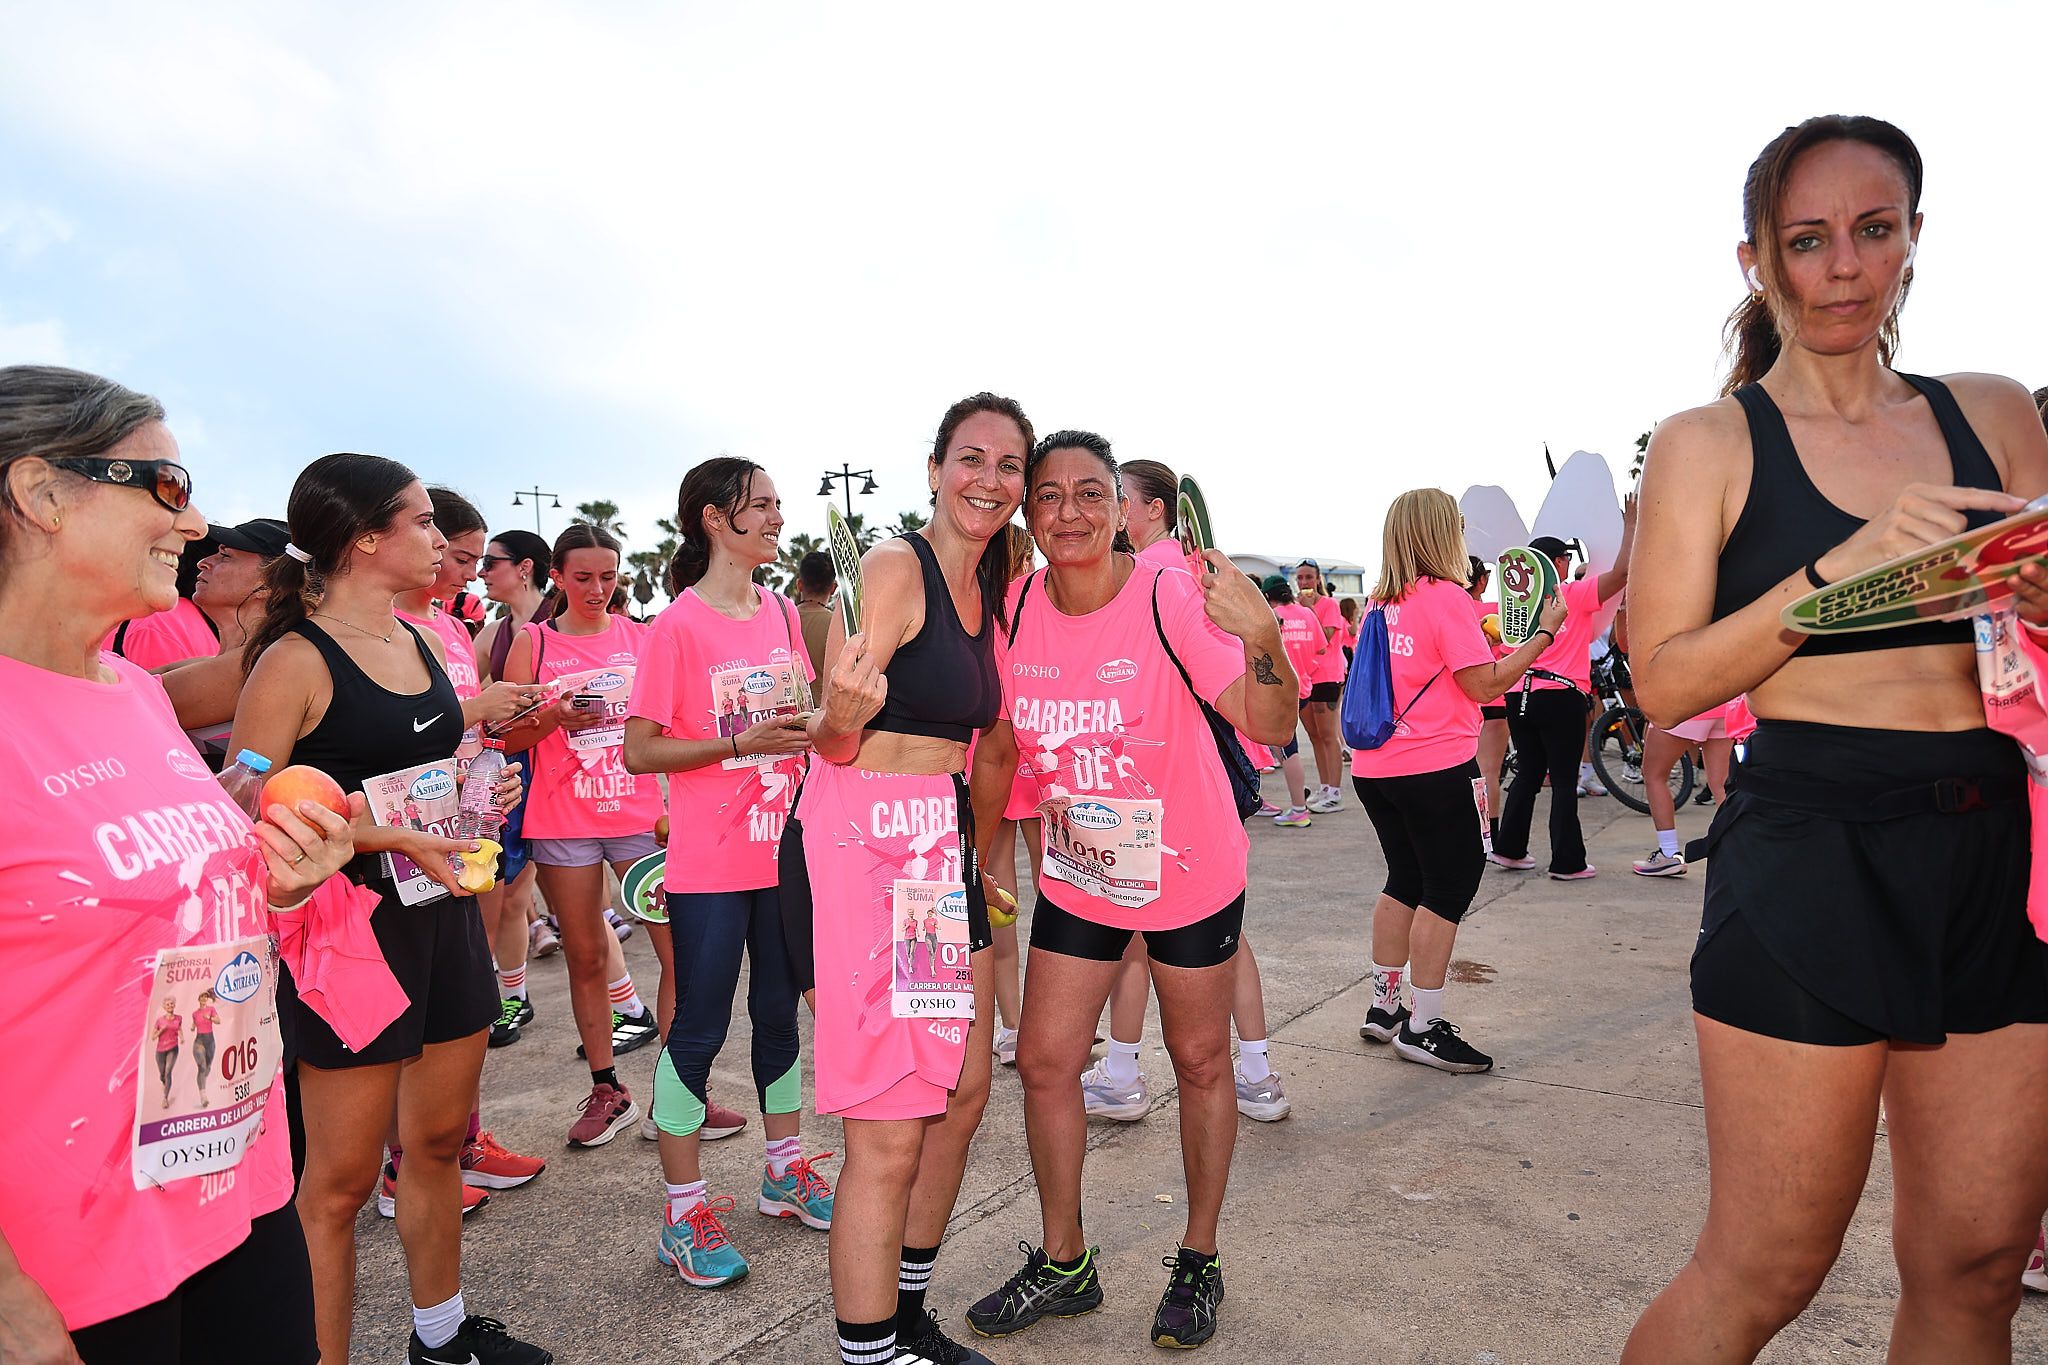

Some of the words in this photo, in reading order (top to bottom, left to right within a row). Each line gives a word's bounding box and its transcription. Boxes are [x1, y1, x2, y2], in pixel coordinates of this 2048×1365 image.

[1819, 551, 1957, 604] CUIDARSE
[1818, 582, 1927, 623] GOZADA
[1820, 600, 1849, 614] ES
[1858, 576, 1915, 602] UNA
[1384, 604, 1400, 626] OS
[1513, 627, 1520, 636] ES
[709, 658, 748, 675] OYSHO
[1013, 663, 1060, 679] OYSHO
[1013, 696, 1125, 734] CARRERA
[580, 735, 607, 745] OYSHO
[44, 757, 126, 797] OYSHO
[1071, 746, 1113, 790] DE
[381, 784, 407, 796] SUMA
[574, 774, 636, 799] MUJER
[596, 799, 620, 813] 2026
[750, 811, 785, 841] MU
[1070, 810, 1117, 825] ASTURIANA
[93, 800, 258, 881] CARRERA
[1072, 841, 1117, 867] 016
[1055, 865, 1087, 886] OYSHO
[1114, 879, 1145, 889] VALENCIA
[907, 893, 934, 902] SUMA
[1108, 890, 1145, 903] Santander
[178, 957, 212, 968] DORSAL
[166, 967, 211, 984] SUMA
[223, 972, 260, 994] ASTURIANA
[909, 982, 941, 991] CARRERA
[943, 982, 952, 991] DE
[953, 983, 962, 991] LA
[910, 998, 956, 1010] OYSHO
[927, 1022, 961, 1044] 2026
[221, 1036, 258, 1081] 016
[160, 1115, 217, 1136] CARRERA
[220, 1112, 232, 1125] DE
[233, 1107, 241, 1120] LA
[162, 1137, 236, 1168] OYSHO
[199, 1168, 235, 1207] 2026
